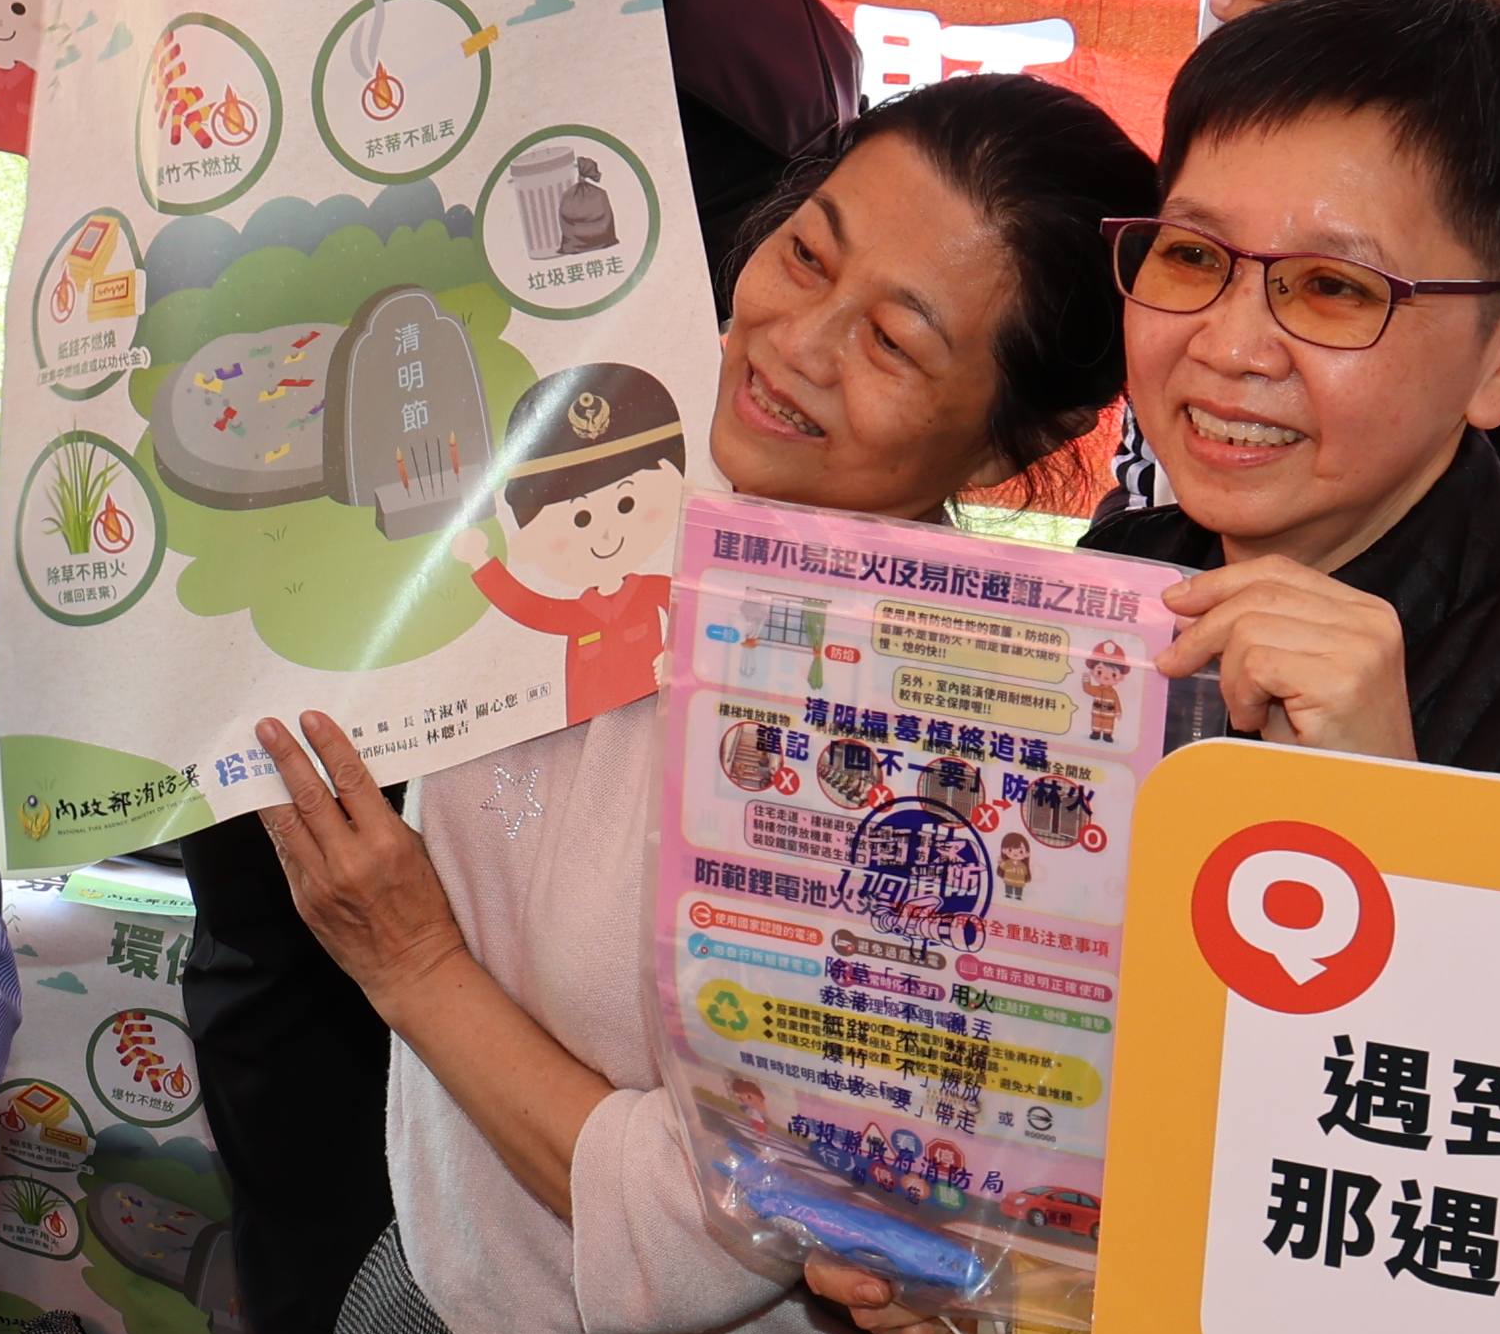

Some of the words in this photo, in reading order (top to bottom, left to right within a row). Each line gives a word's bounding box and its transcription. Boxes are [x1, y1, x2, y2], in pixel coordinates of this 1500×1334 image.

[365, 120, 456, 160] 菸蒂不亂丟
[527, 256, 626, 292] 垃圾要帶走
[394, 322, 431, 434] 清明節
[45, 559, 129, 585] 除草不用火
[829, 646, 855, 663] 防焰
[475, 693, 519, 720] 關心您
